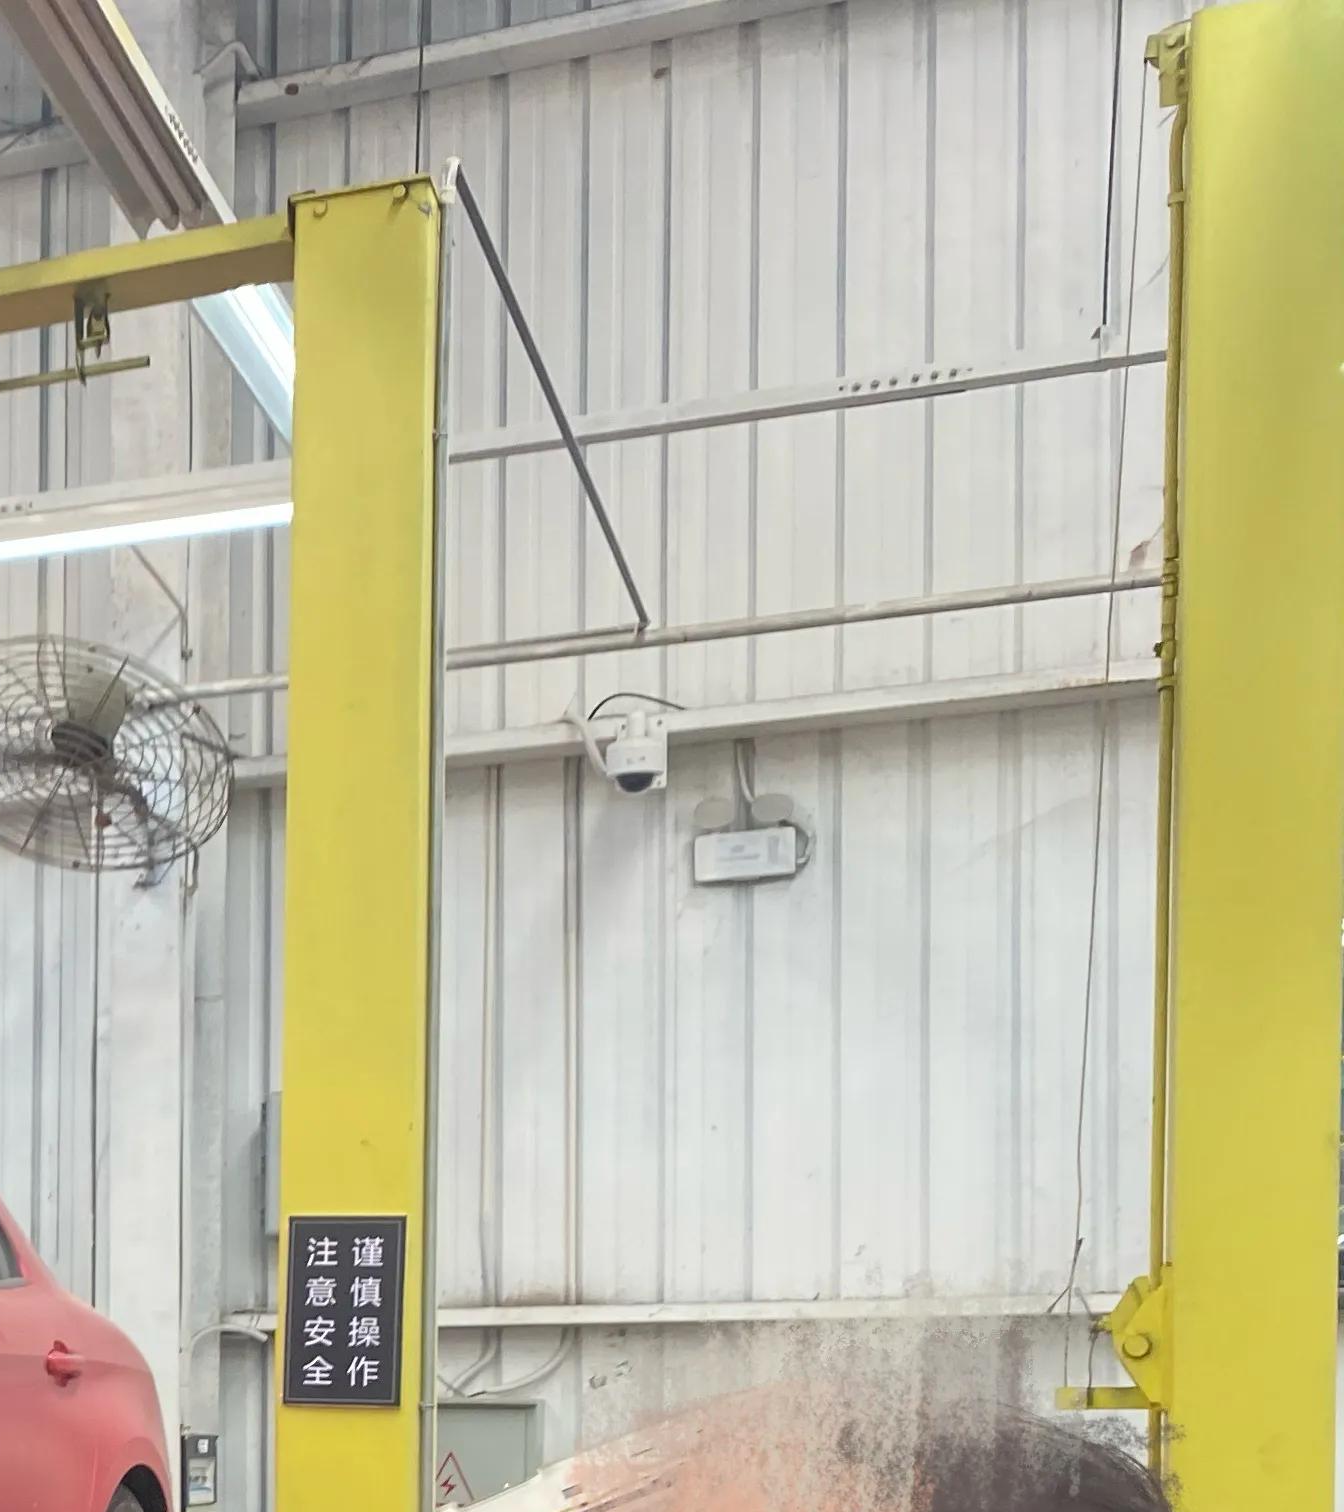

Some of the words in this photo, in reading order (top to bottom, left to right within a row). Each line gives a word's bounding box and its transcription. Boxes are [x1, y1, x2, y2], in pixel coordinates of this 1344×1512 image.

[302, 1236, 338, 1386] 注意安全
[346, 1236, 384, 1387] 谨慎操作
